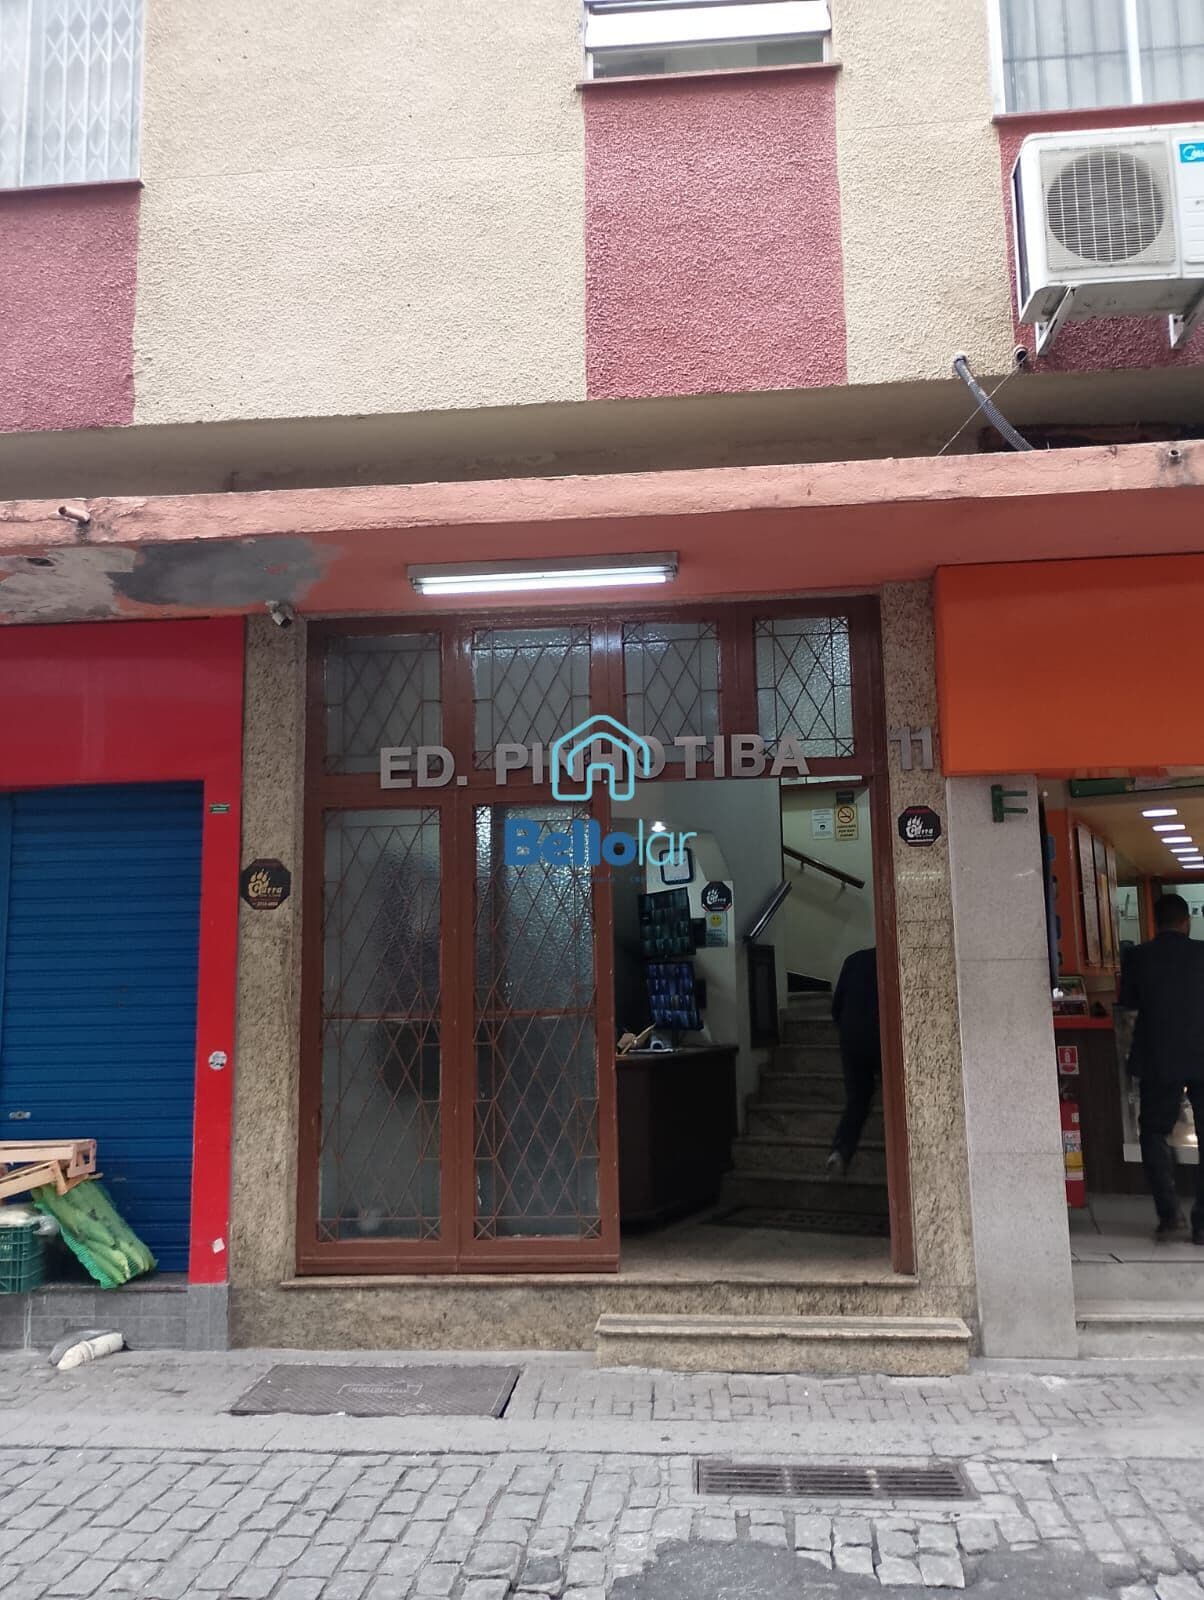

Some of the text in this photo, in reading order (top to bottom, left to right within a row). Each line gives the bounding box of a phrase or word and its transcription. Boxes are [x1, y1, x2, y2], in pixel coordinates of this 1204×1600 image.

[380, 734, 810, 789] ED. PINHOTIBA
[889, 727, 934, 770] 11
